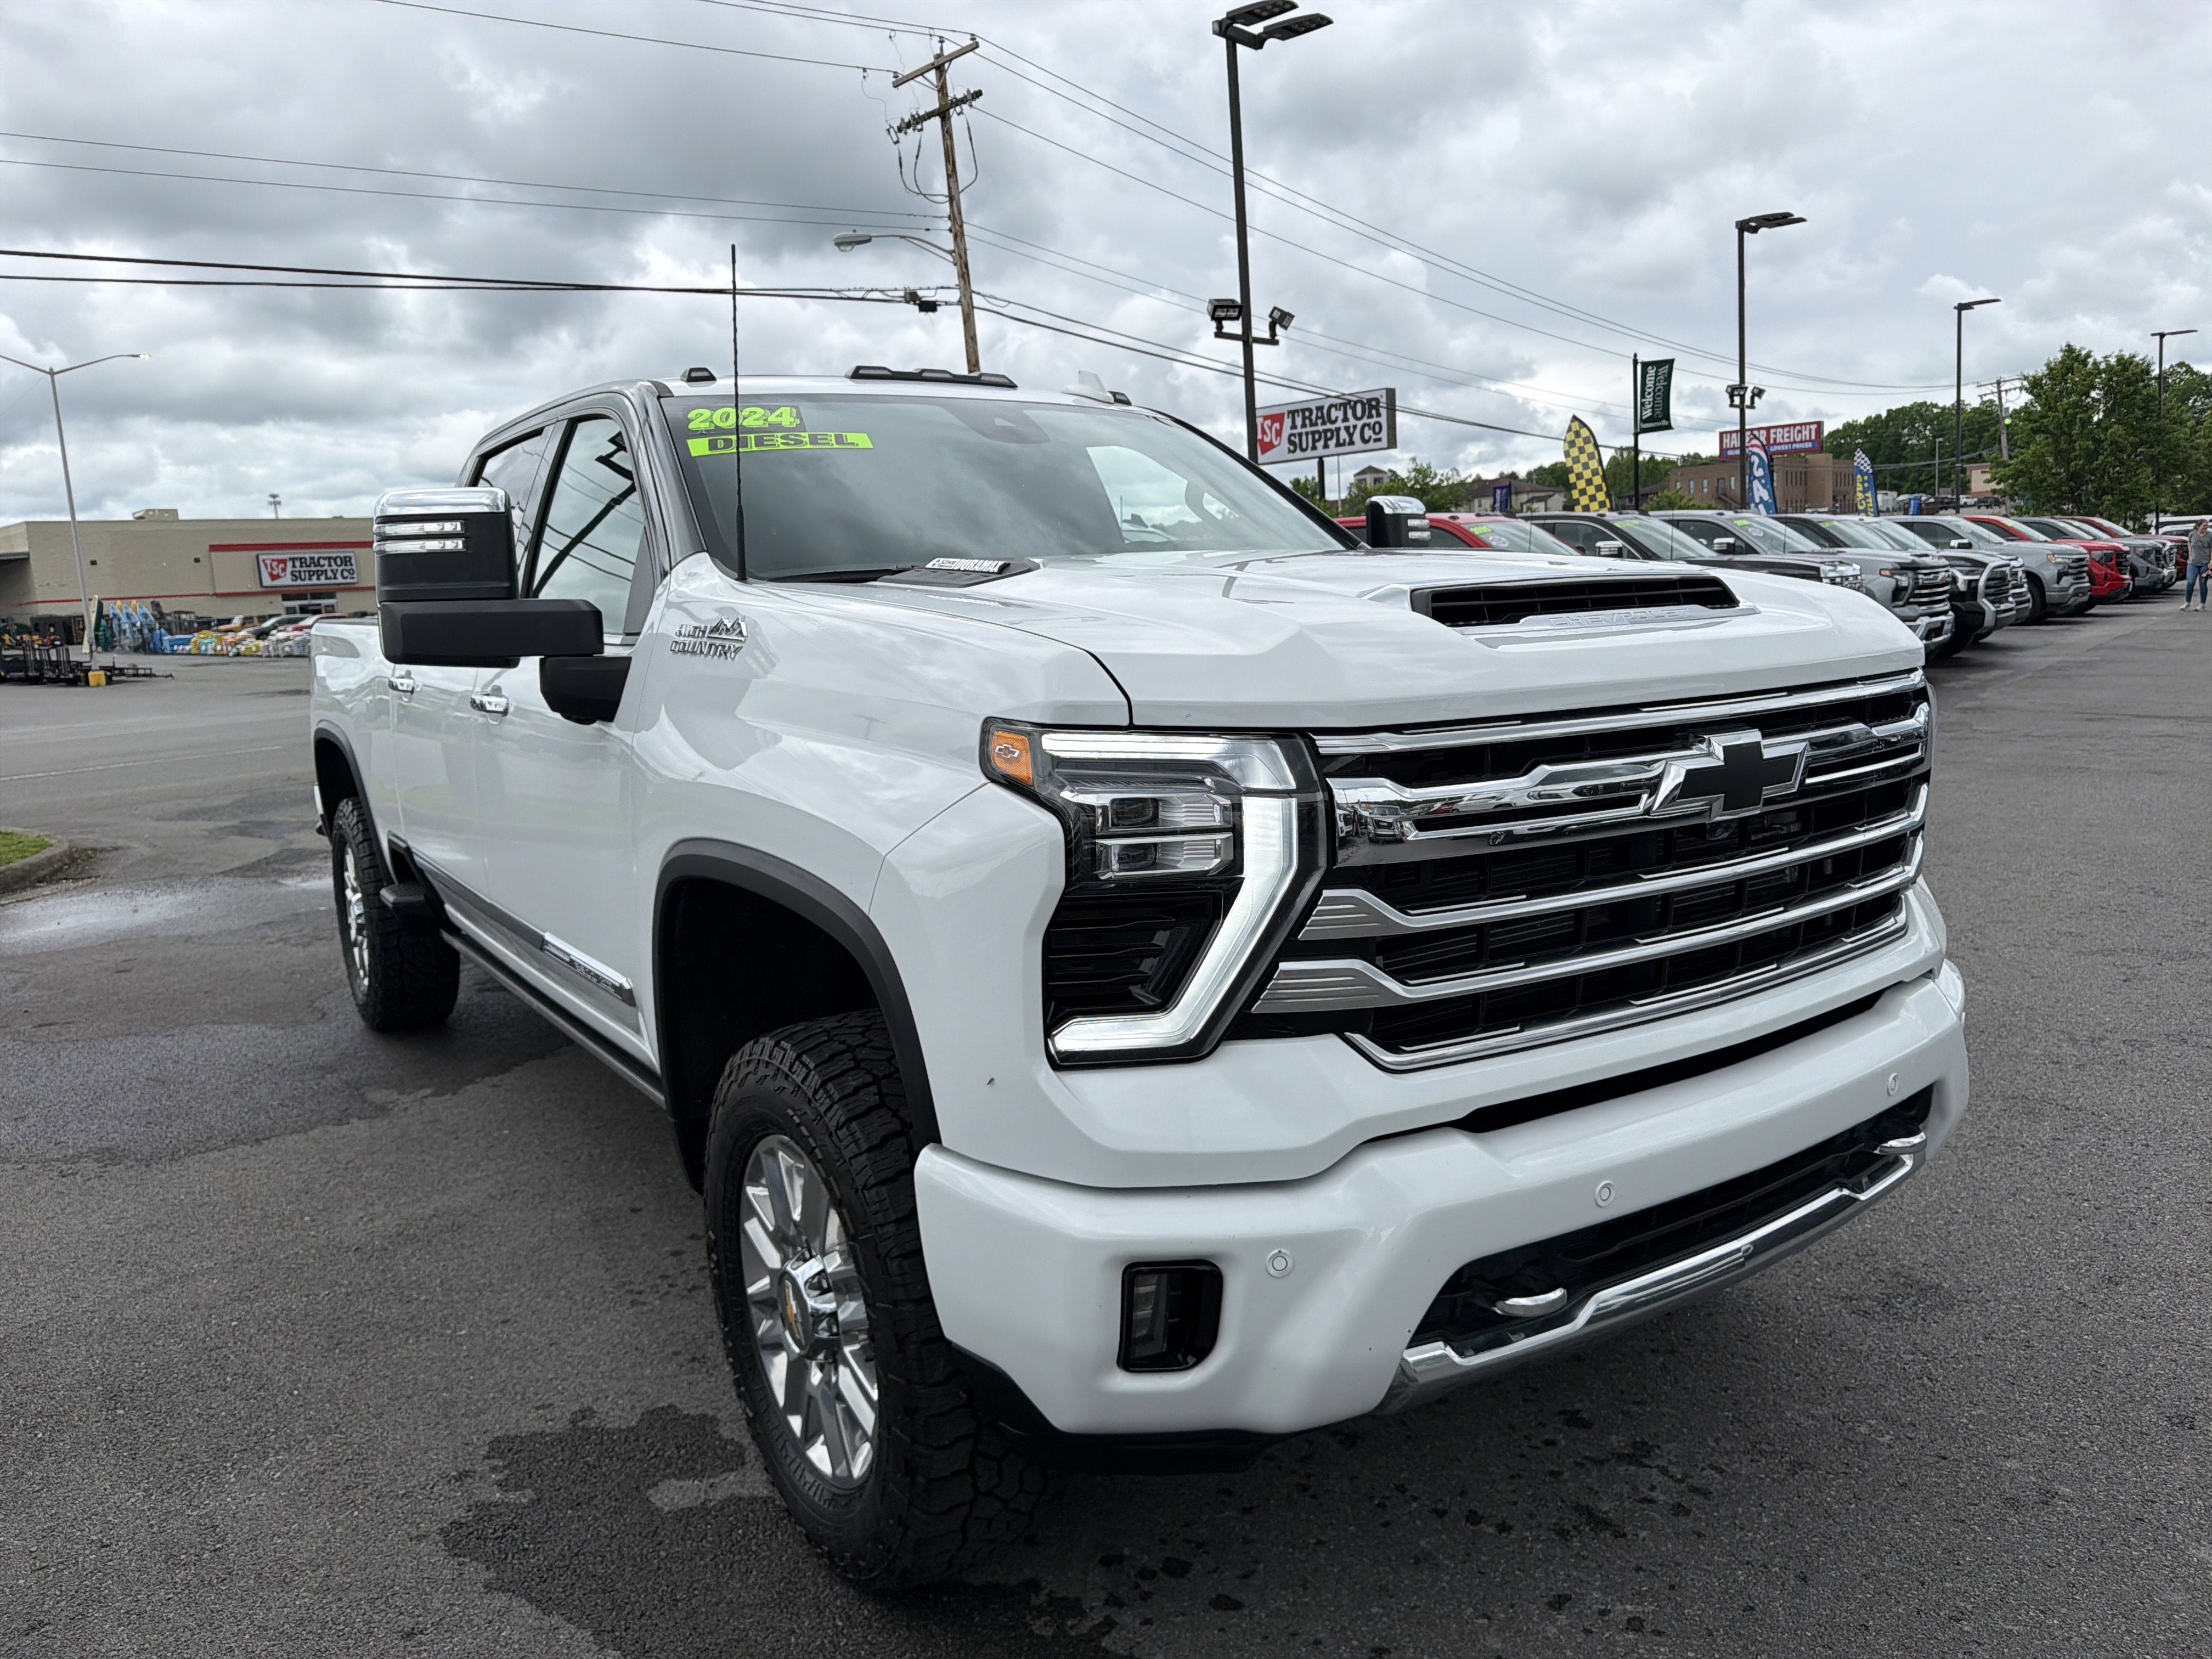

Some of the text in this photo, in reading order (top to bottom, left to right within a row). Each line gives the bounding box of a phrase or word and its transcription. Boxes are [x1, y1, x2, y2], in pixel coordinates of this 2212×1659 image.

[1641, 365, 1656, 420] Welcome
[1654, 364, 1669, 419] Welcome
[687, 407, 800, 430] 2024
[1287, 397, 1382, 430] TRACTOR
[1256, 417, 1280, 446] TSC
[1287, 424, 1357, 454] SUPPLY
[1770, 424, 1818, 444] FREIGHT
[708, 433, 859, 453] DIESEL
[264, 560, 285, 577] TSC
[289, 556, 353, 568] TRACTOR
[953, 559, 1006, 573] DURAMAX
[290, 568, 338, 582] SUPPLY
[1549, 608, 1688, 627] CHEVROLET
[670, 640, 743, 659] COUNTRY
